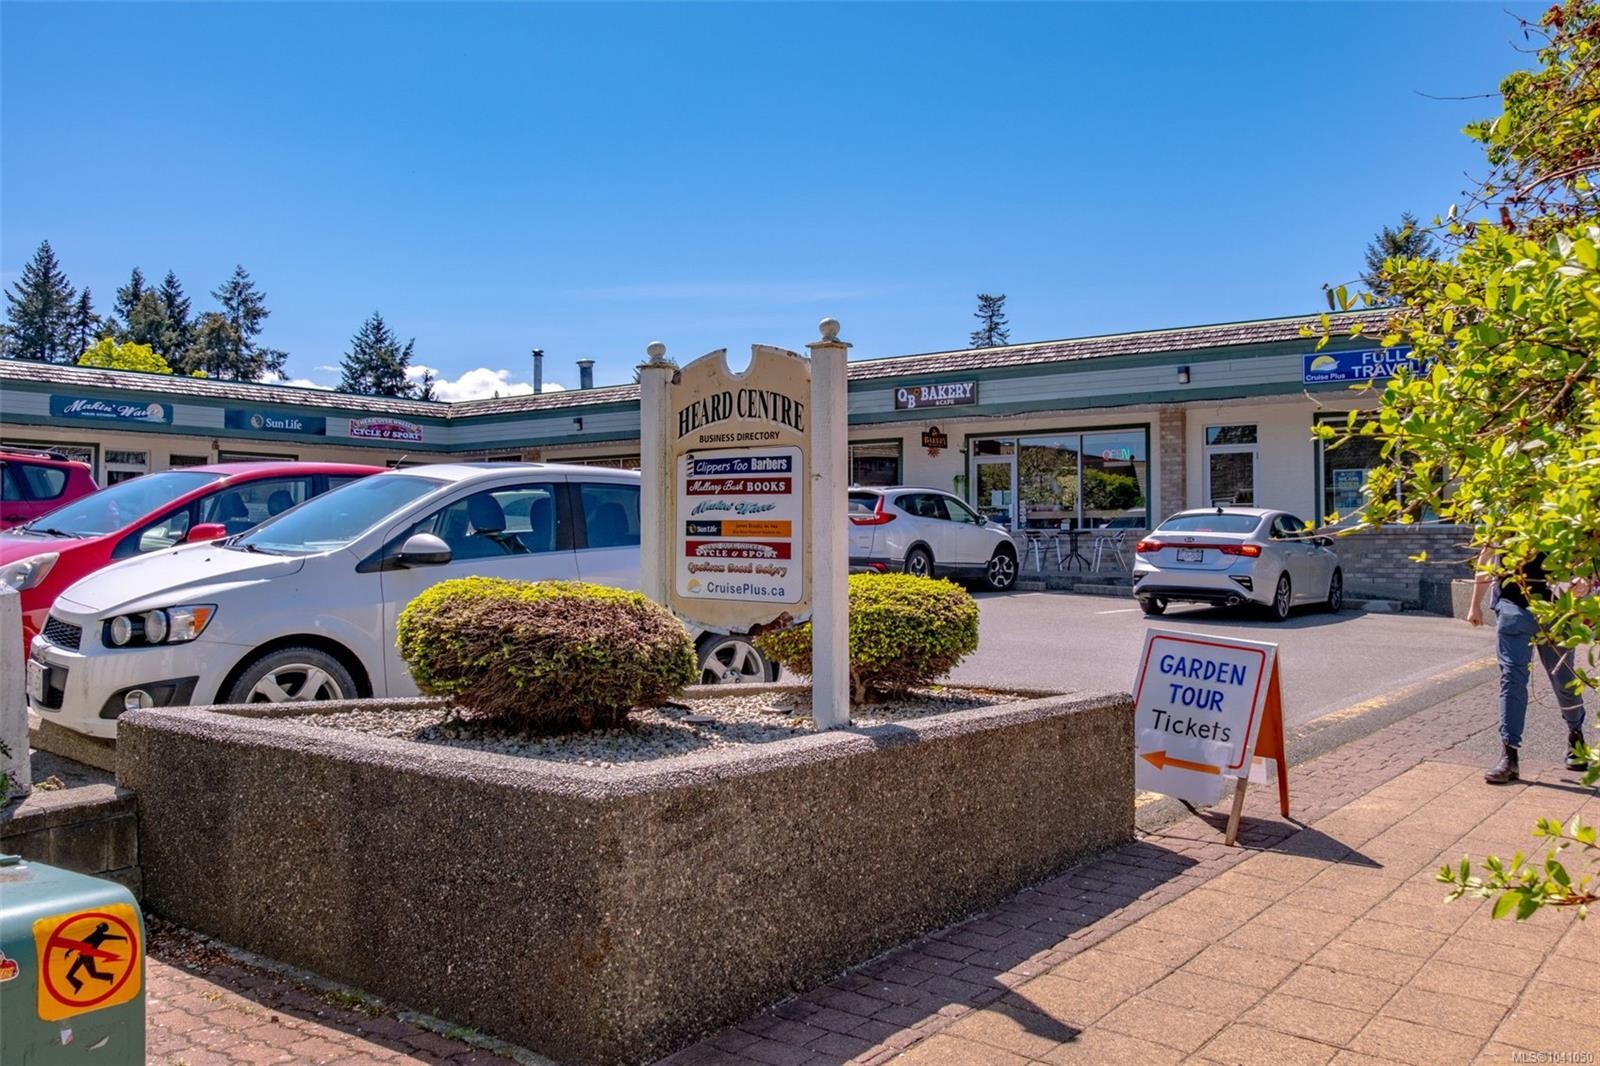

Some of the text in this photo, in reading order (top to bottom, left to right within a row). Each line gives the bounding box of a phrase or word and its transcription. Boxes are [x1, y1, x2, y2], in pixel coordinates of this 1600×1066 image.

[1362, 350, 1406, 364] FULL
[1306, 374, 1328, 382] Cruise
[921, 384, 973, 400] BAKERY
[64, 400, 116, 414] Makin'
[678, 388, 804, 439] HEARD CENTRE
[266, 417, 303, 430] Sun Life
[353, 428, 381, 437] CYCLE
[392, 431, 420, 440] SPORT
[699, 431, 780, 443] BUSINESS DIRECTORY
[696, 458, 788, 474] Clippers Too Barbers
[746, 482, 786, 492] BOOKS
[695, 549, 728, 557] CYCLE
[742, 550, 778, 558] SPORT
[707, 581, 785, 597] CruisePlus.ca
[1159, 654, 1248, 686] GARDEN
[1169, 683, 1225, 712] TOUR
[1151, 708, 1232, 743] Tickets
